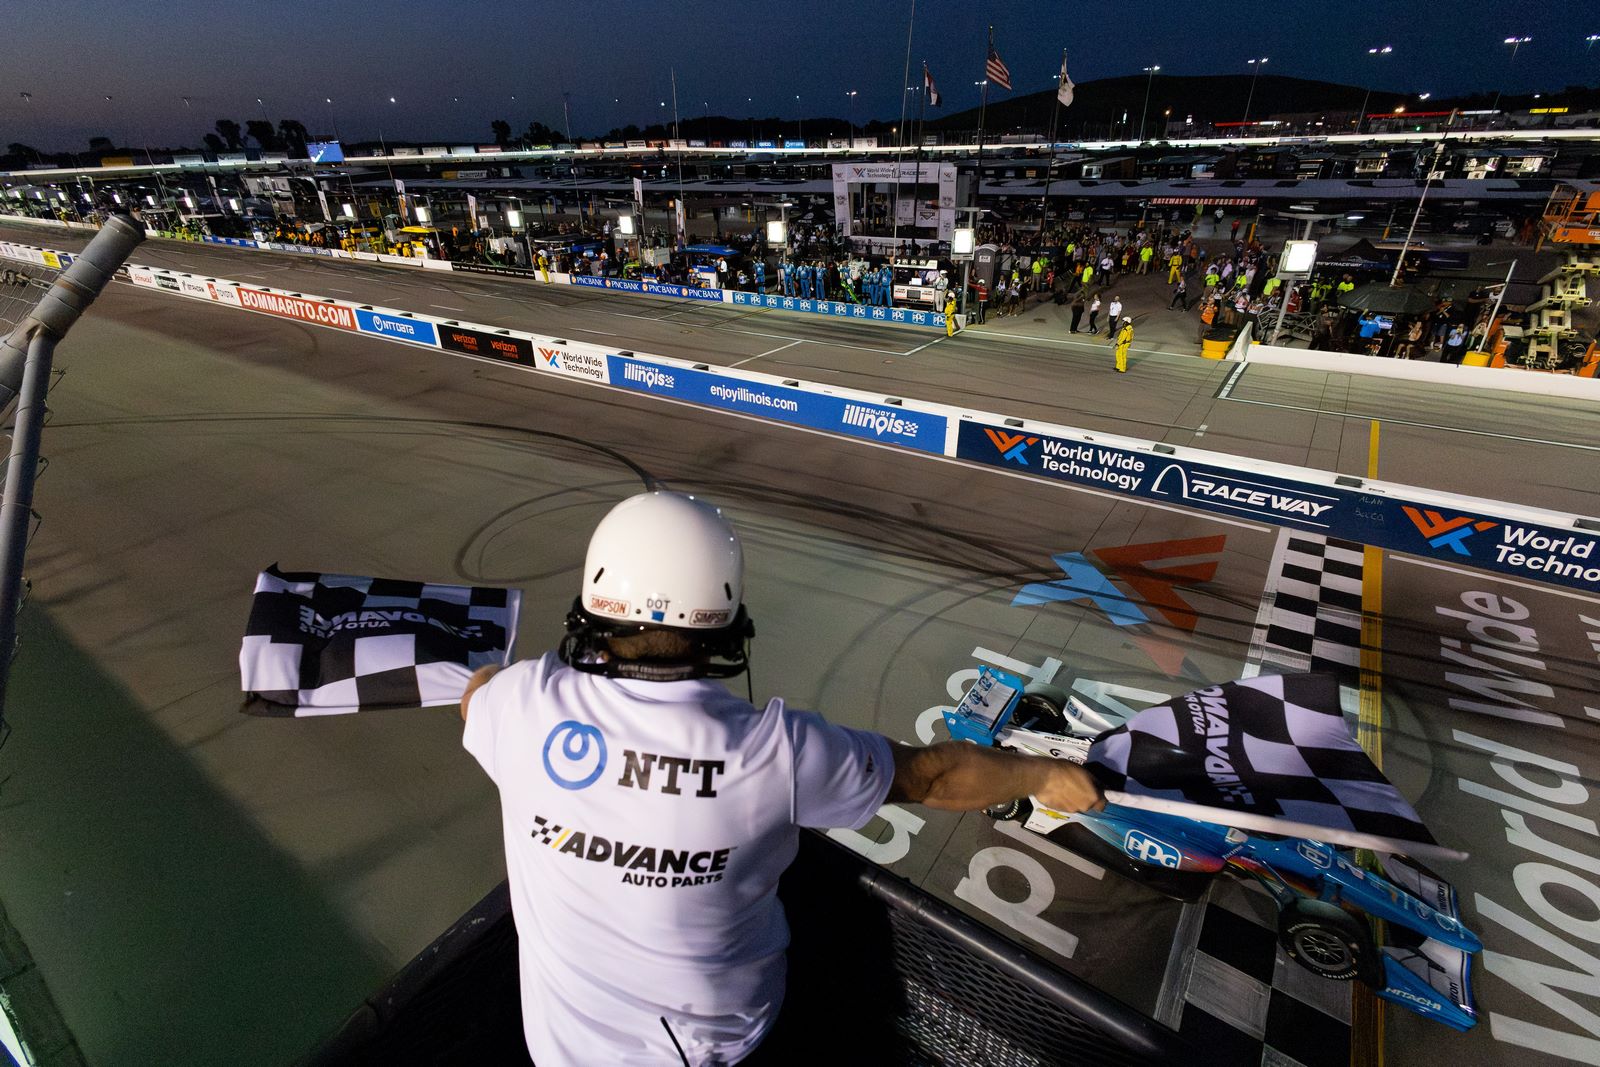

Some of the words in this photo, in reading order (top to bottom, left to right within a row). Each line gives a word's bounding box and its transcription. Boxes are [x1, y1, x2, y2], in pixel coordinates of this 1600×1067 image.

[240, 290, 352, 328] BOMMARITO.COM
[452, 333, 478, 346] verizon
[490, 340, 518, 353] verizon
[561, 351, 583, 364] World
[584, 355, 603, 368] Wide
[563, 361, 604, 379] Technology
[710, 383, 798, 412] enjoyillinois.com
[857, 407, 891, 417] ENJOY
[842, 404, 905, 436] illinois
[1042, 439, 1097, 463] World
[1098, 447, 1146, 473] Wide
[1040, 454, 1142, 491] Technology
[1191, 479, 1334, 518] RACEWAY
[1504, 524, 1596, 560] World
[1496, 544, 1600, 583] Techno
[590, 597, 626, 614] SIMPSON
[646, 597, 671, 610] DOT
[1434, 590, 1566, 729] Wide
[617, 749, 725, 798] NTT
[559, 830, 731, 875] ADVANCE
[1127, 836, 1178, 869] PPG
[621, 872, 668, 888] AUTO
[671, 872, 724, 888] PARTS
[1385, 986, 1442, 1012] HITACHI
